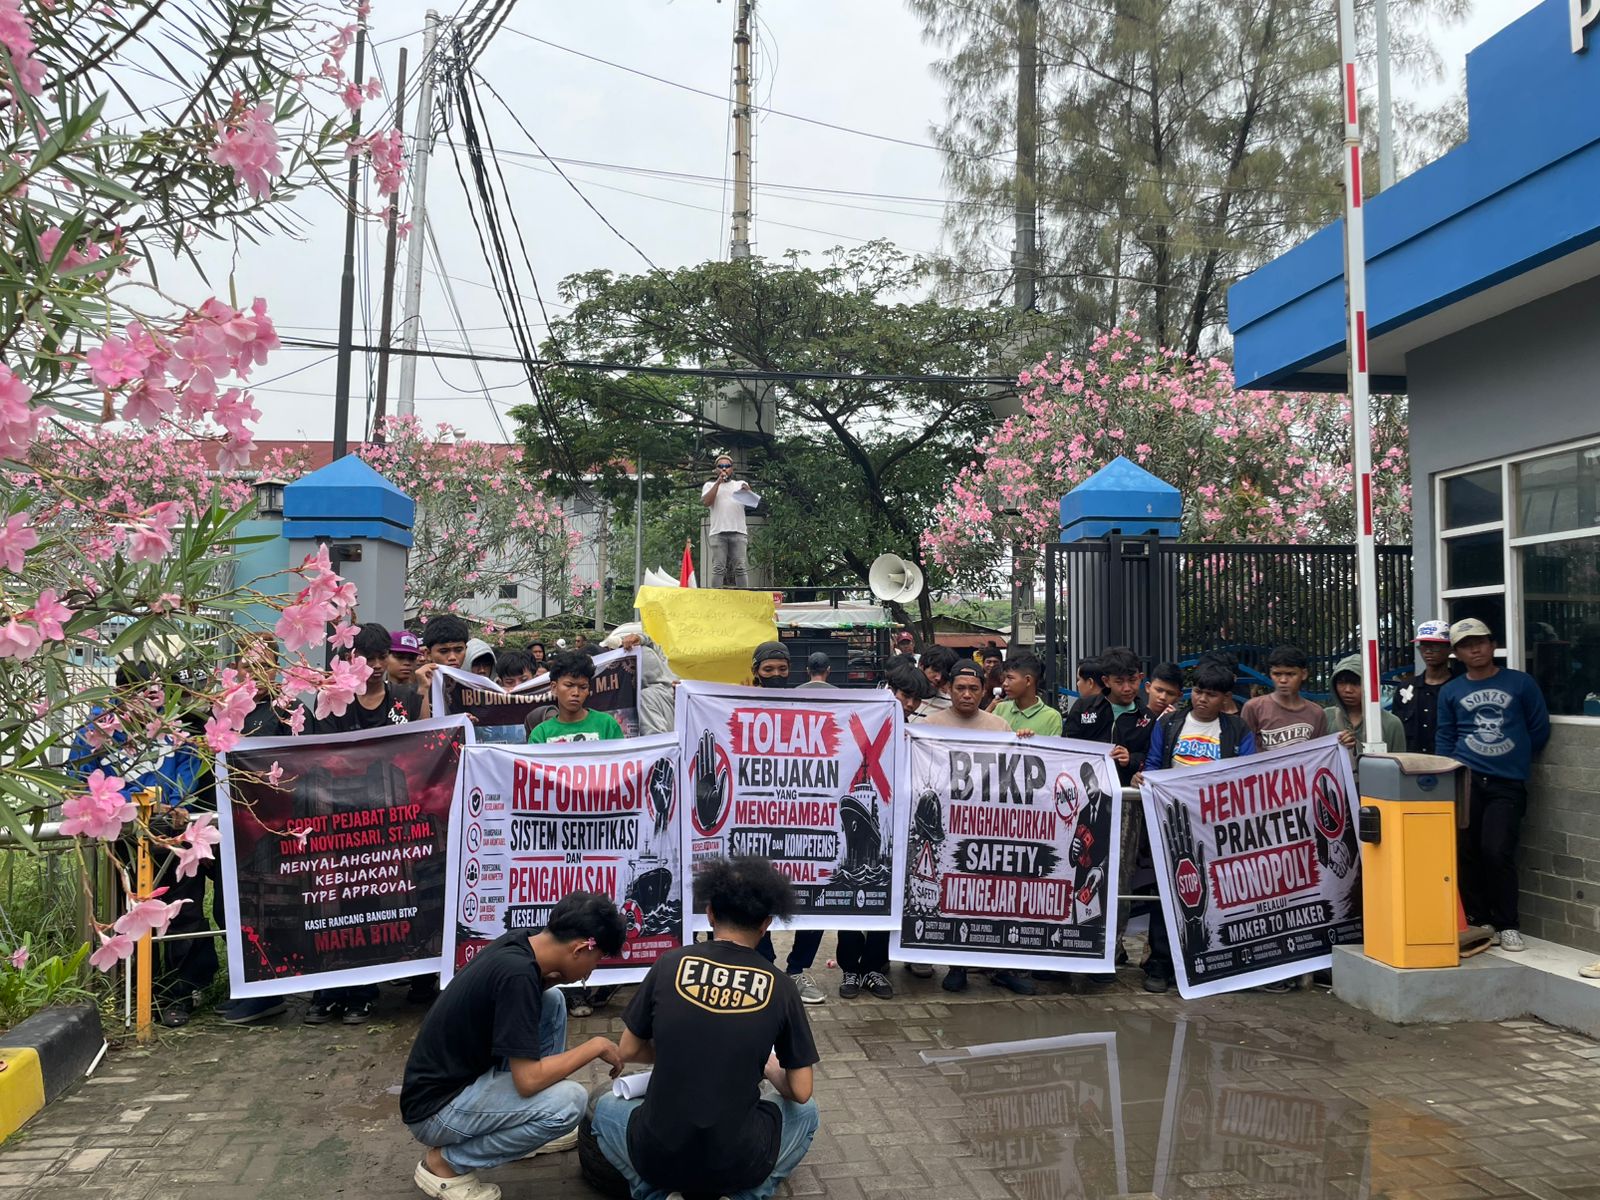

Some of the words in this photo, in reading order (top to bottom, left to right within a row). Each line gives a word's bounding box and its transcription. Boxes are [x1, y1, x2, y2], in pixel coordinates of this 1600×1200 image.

[461, 689, 481, 706] IBU
[484, 690, 511, 705] DINI
[596, 673, 619, 693] M.H
[738, 712, 827, 755] TOLAK
[512, 759, 642, 812] REFORMASI
[738, 757, 839, 788] KEBIJAKAN
[950, 751, 1046, 805] BTKP
[776, 789, 797, 800] YANG
[1200, 765, 1307, 824] HENTIKAN
[332, 808, 385, 830] PEJABAT
[389, 804, 421, 823] BTKP
[735, 801, 838, 826] MENGHAMBAT
[950, 804, 1057, 840] MENGHANCURKAN
[310, 829, 385, 853] NOVITASARI,
[510, 819, 557, 850] SISTEM
[562, 819, 639, 850] SERTIFIKASI
[733, 831, 772, 857] SAFETY
[772, 840, 784, 850] DAN
[784, 833, 836, 858] KOMPETENSI
[1214, 806, 1312, 856] PRAKTEK
[280, 844, 433, 874] MENYALAHGUNAKAN
[565, 853, 581, 864] DAN
[966, 843, 1043, 877] SAFETY,
[315, 865, 398, 886] KEBIJAKAN
[508, 866, 617, 903] PENGAWASAN
[1178, 873, 1198, 893] STOP
[1216, 845, 1312, 904] MONOPOLY
[302, 889, 336, 904] TYPE
[342, 879, 416, 899] APPROVAL
[946, 877, 1016, 913] MENGEJAR
[1020, 881, 1066, 916] PUNGLI
[1256, 899, 1288, 913] MELALUI
[304, 917, 327, 931] KASIE
[328, 913, 364, 928] RANCANG
[366, 909, 397, 922] BANGUN
[398, 906, 418, 918] BTKP
[1228, 915, 1268, 942] MAKER
[1269, 912, 1284, 931] TO
[1286, 904, 1325, 929] MAKER
[314, 927, 367, 953] MAFIA
[370, 920, 411, 945] BTKP
[681, 960, 768, 1001] EIGER
[702, 985, 742, 1007] 1989
